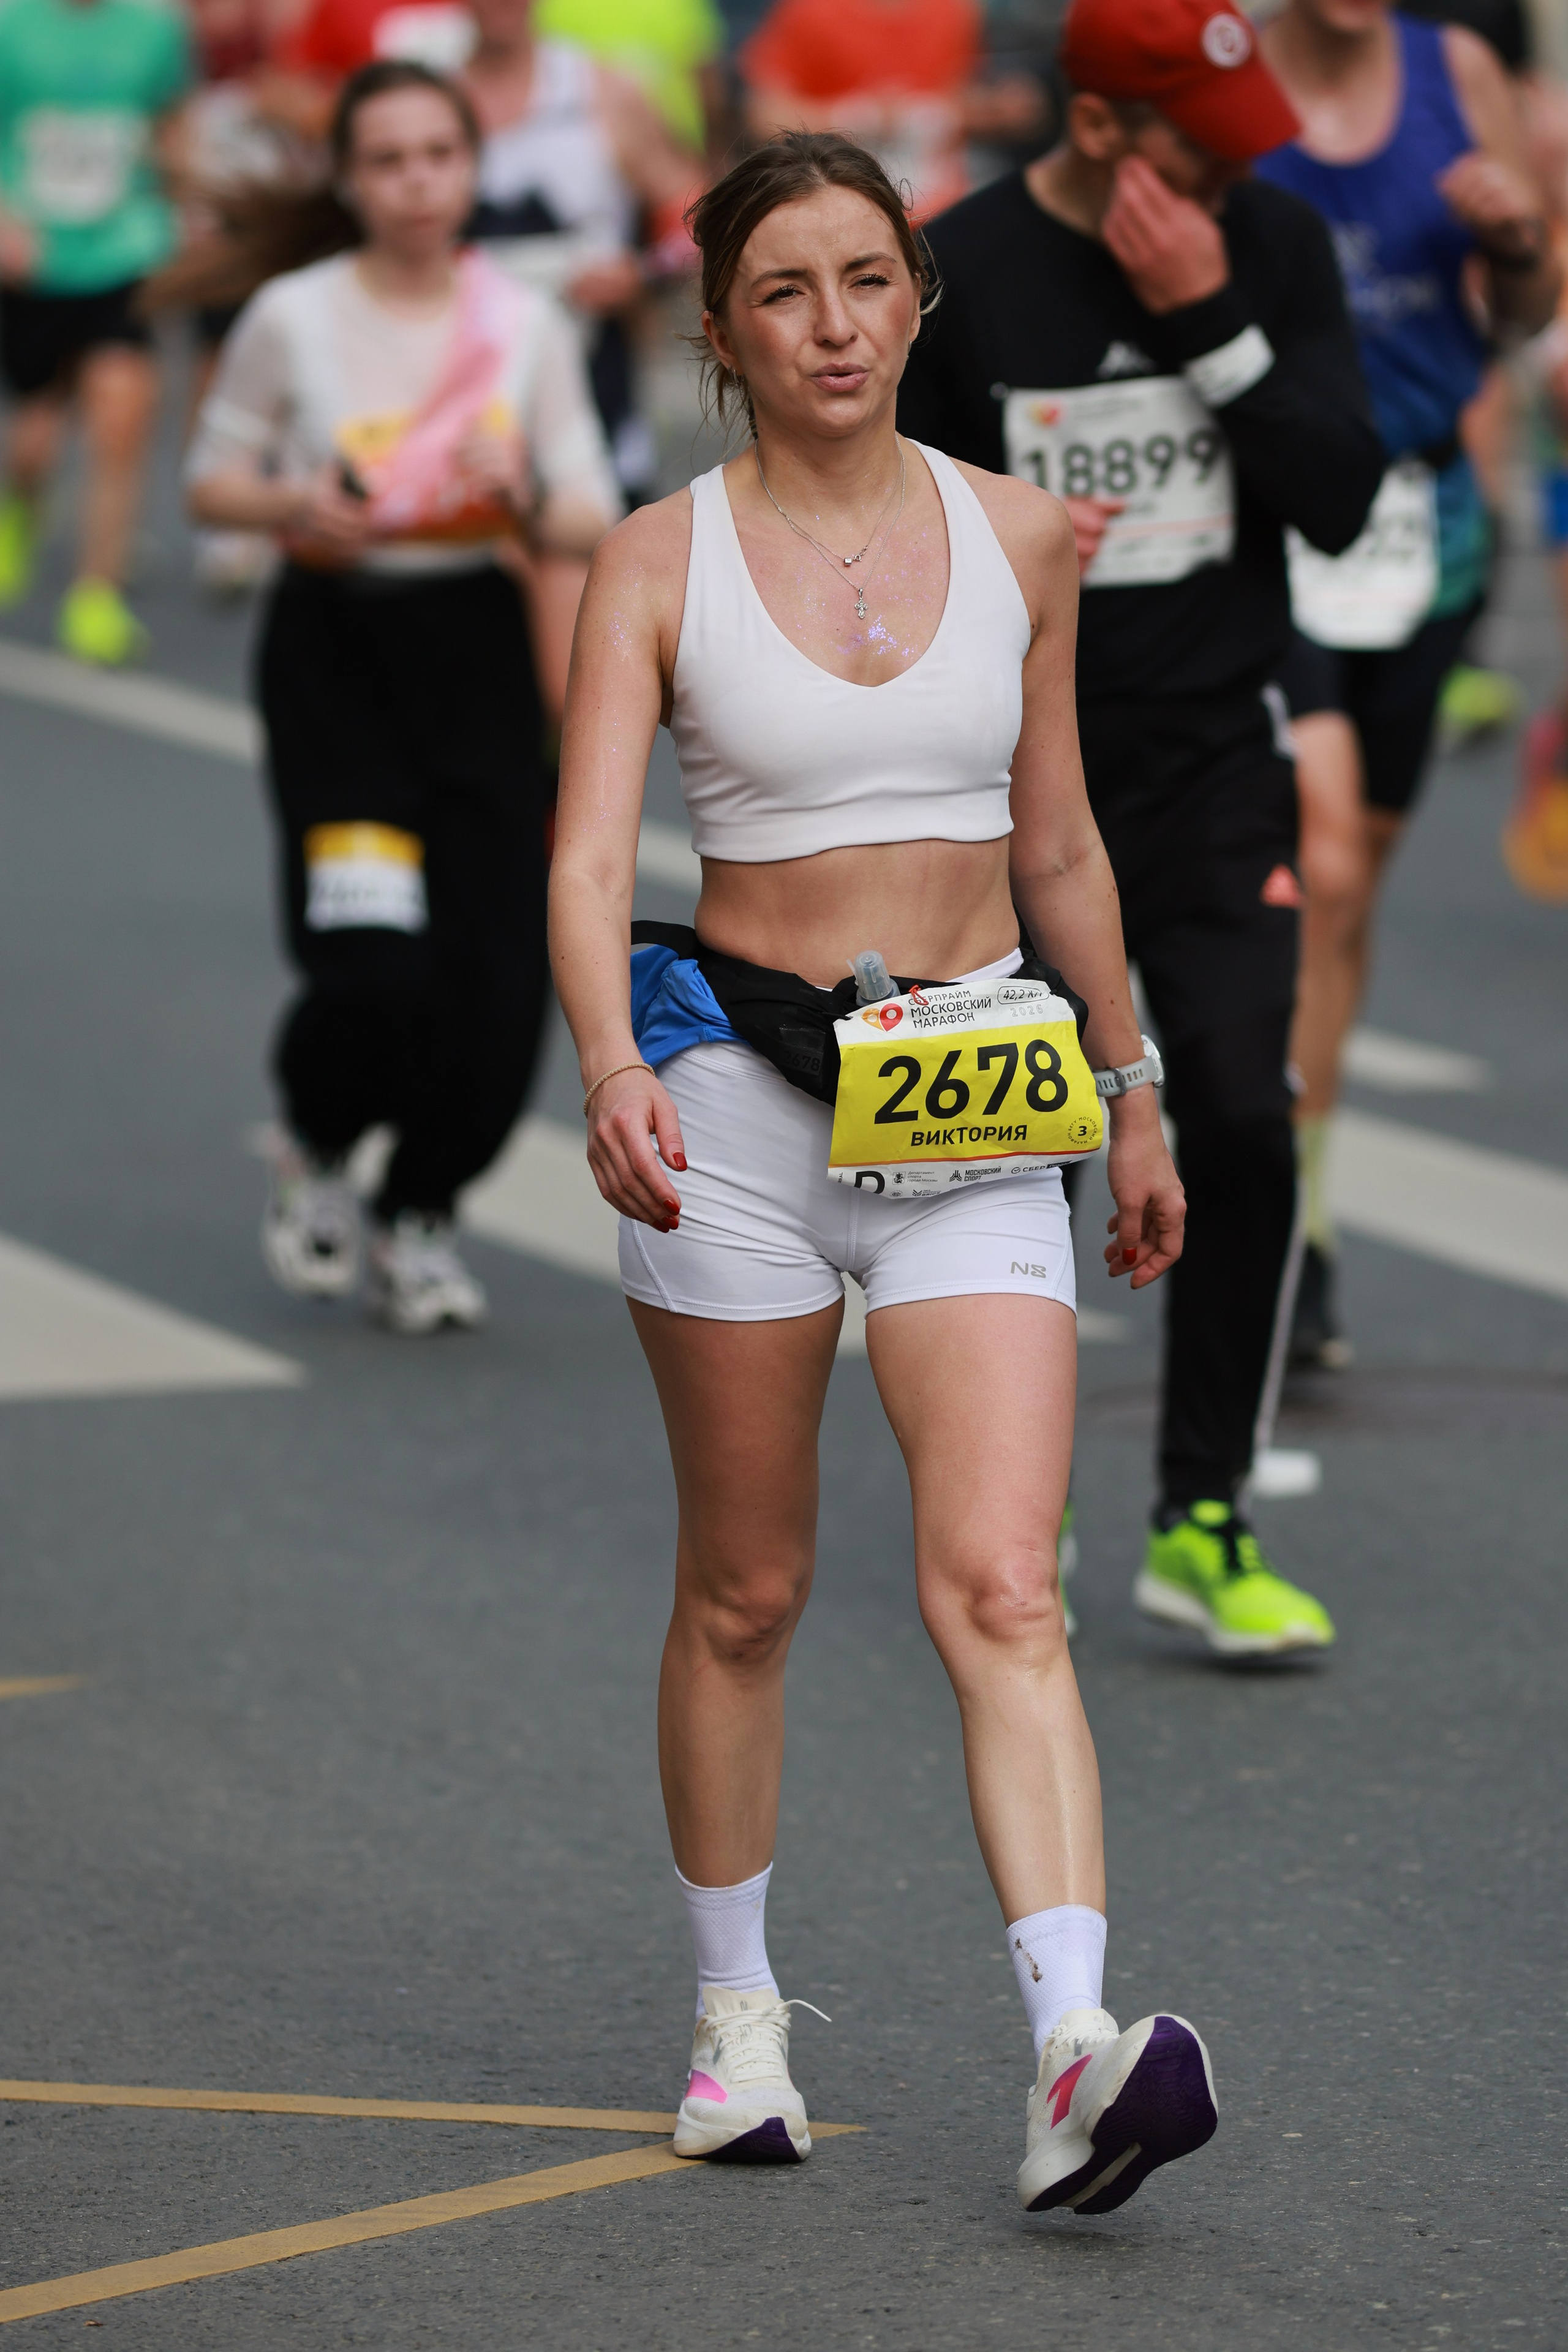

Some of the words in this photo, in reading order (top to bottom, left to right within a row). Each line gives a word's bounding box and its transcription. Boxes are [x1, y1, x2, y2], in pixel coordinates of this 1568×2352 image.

[1022, 431, 1221, 498] 18899
[1003, 989, 1025, 1000] 42,2
[911, 996, 992, 1017] МОСКОВСКИЙ
[1011, 1004, 1043, 1017] 2026
[913, 1012, 975, 1028] МАРАФОН
[874, 1039, 1068, 1125] 2678
[911, 1125, 1028, 1147] ВИКТОРИЯ
[1077, 1125, 1087, 1136] 3
[965, 1166, 1001, 1175] МОСКОВСКИЙ
